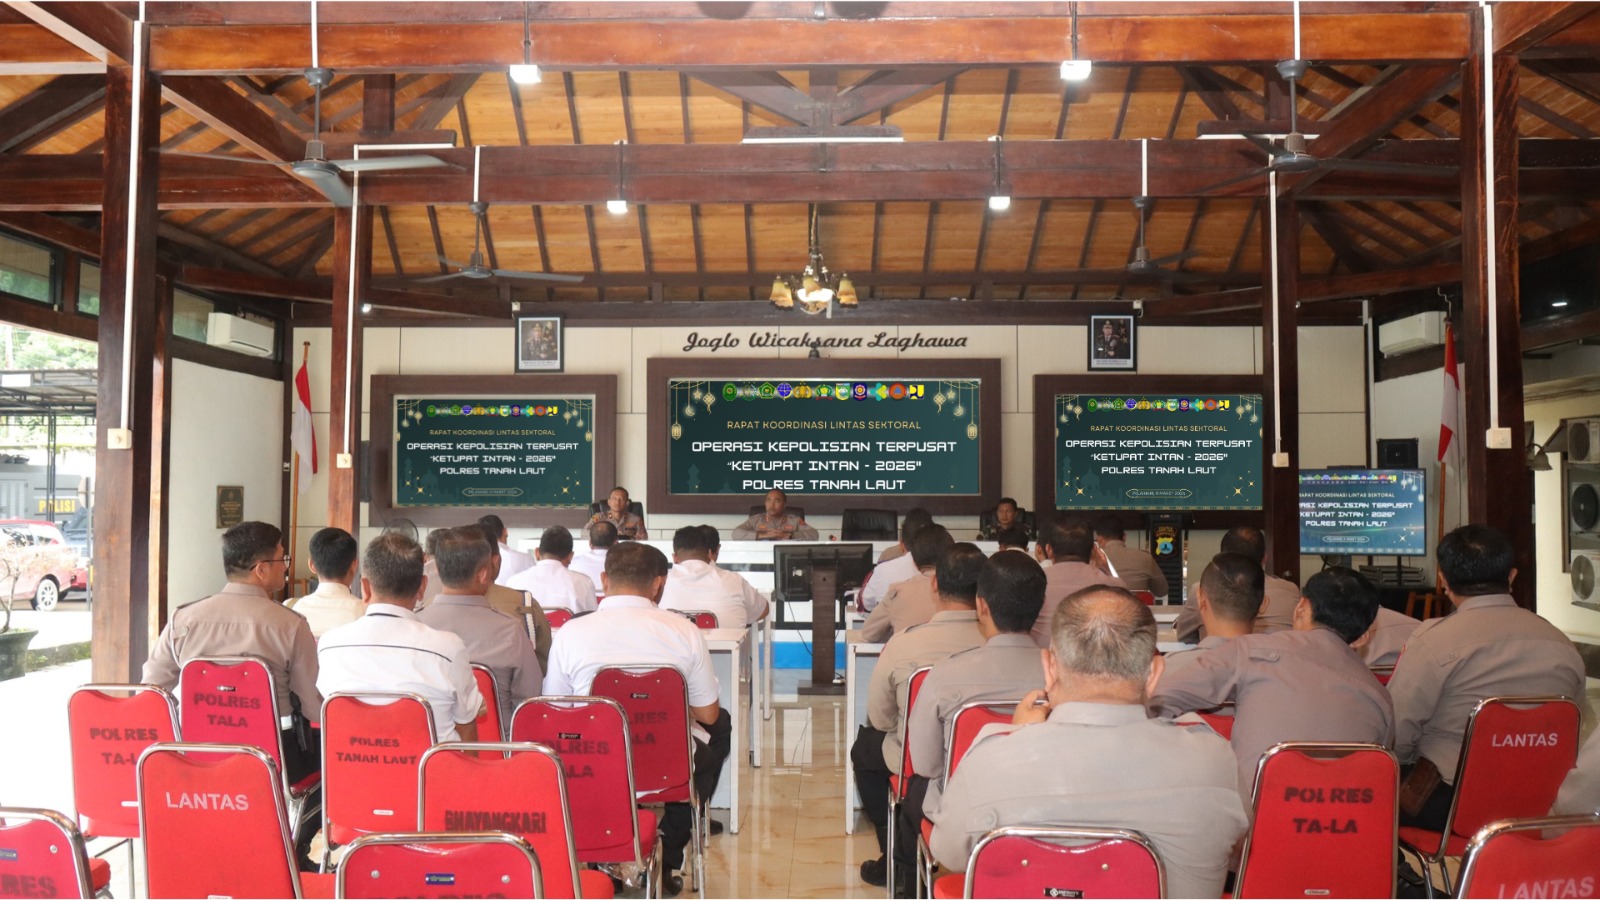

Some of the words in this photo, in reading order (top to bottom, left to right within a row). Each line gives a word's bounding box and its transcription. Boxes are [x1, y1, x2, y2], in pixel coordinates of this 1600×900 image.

[682, 332, 740, 353] Joglo
[748, 332, 863, 353] Wicaksana
[866, 332, 968, 352] Laghawa
[727, 420, 760, 430] RAPAT
[763, 420, 827, 430] KOORDINASI
[830, 420, 866, 430] LINTAS
[868, 420, 922, 430] SEKTORAL
[406, 442, 453, 450] OPERASI
[456, 442, 523, 450] KEPOLISIAN
[526, 442, 579, 450] TERPUSAT
[691, 441, 764, 452] OPERASI
[768, 441, 871, 452] KEPOLISIAN
[875, 441, 957, 452] TERPUSAT
[1065, 439, 1116, 448] OPERASI
[1119, 439, 1192, 448] KEPOLISIAN
[1196, 439, 1253, 448] TERPUSAT
[482, 455, 516, 463] INTAN
[1147, 453, 1184, 461] INTAN
[439, 467, 480, 475] POLRES
[482, 467, 517, 475] TANAH
[518, 467, 546, 475] LAUT
[808, 460, 860, 471] INTAN
[875, 460, 922, 471] 2026"
[1101, 466, 1145, 474] POLRES
[1148, 466, 1185, 474] TANAH
[1187, 466, 1217, 474] LAUT
[742, 480, 804, 490] POLRES
[809, 480, 860, 490] TANAH
[865, 480, 906, 490] LAUT
[194, 693, 261, 709] POLRES
[206, 714, 248, 728] TALA
[89, 728, 159, 740] POLRES
[350, 737, 400, 747] POLRES
[1491, 733, 1558, 748] LANTAS
[541, 740, 609, 755] LRES
[101, 752, 136, 765] TA-L
[336, 752, 379, 763] TANAH
[383, 756, 416, 765] LAUT
[165, 791, 249, 811] LANTAS
[1284, 786, 1373, 804] POLRES
[1293, 818, 1358, 834] TA-LA
[1498, 876, 1595, 899] LANTAS
